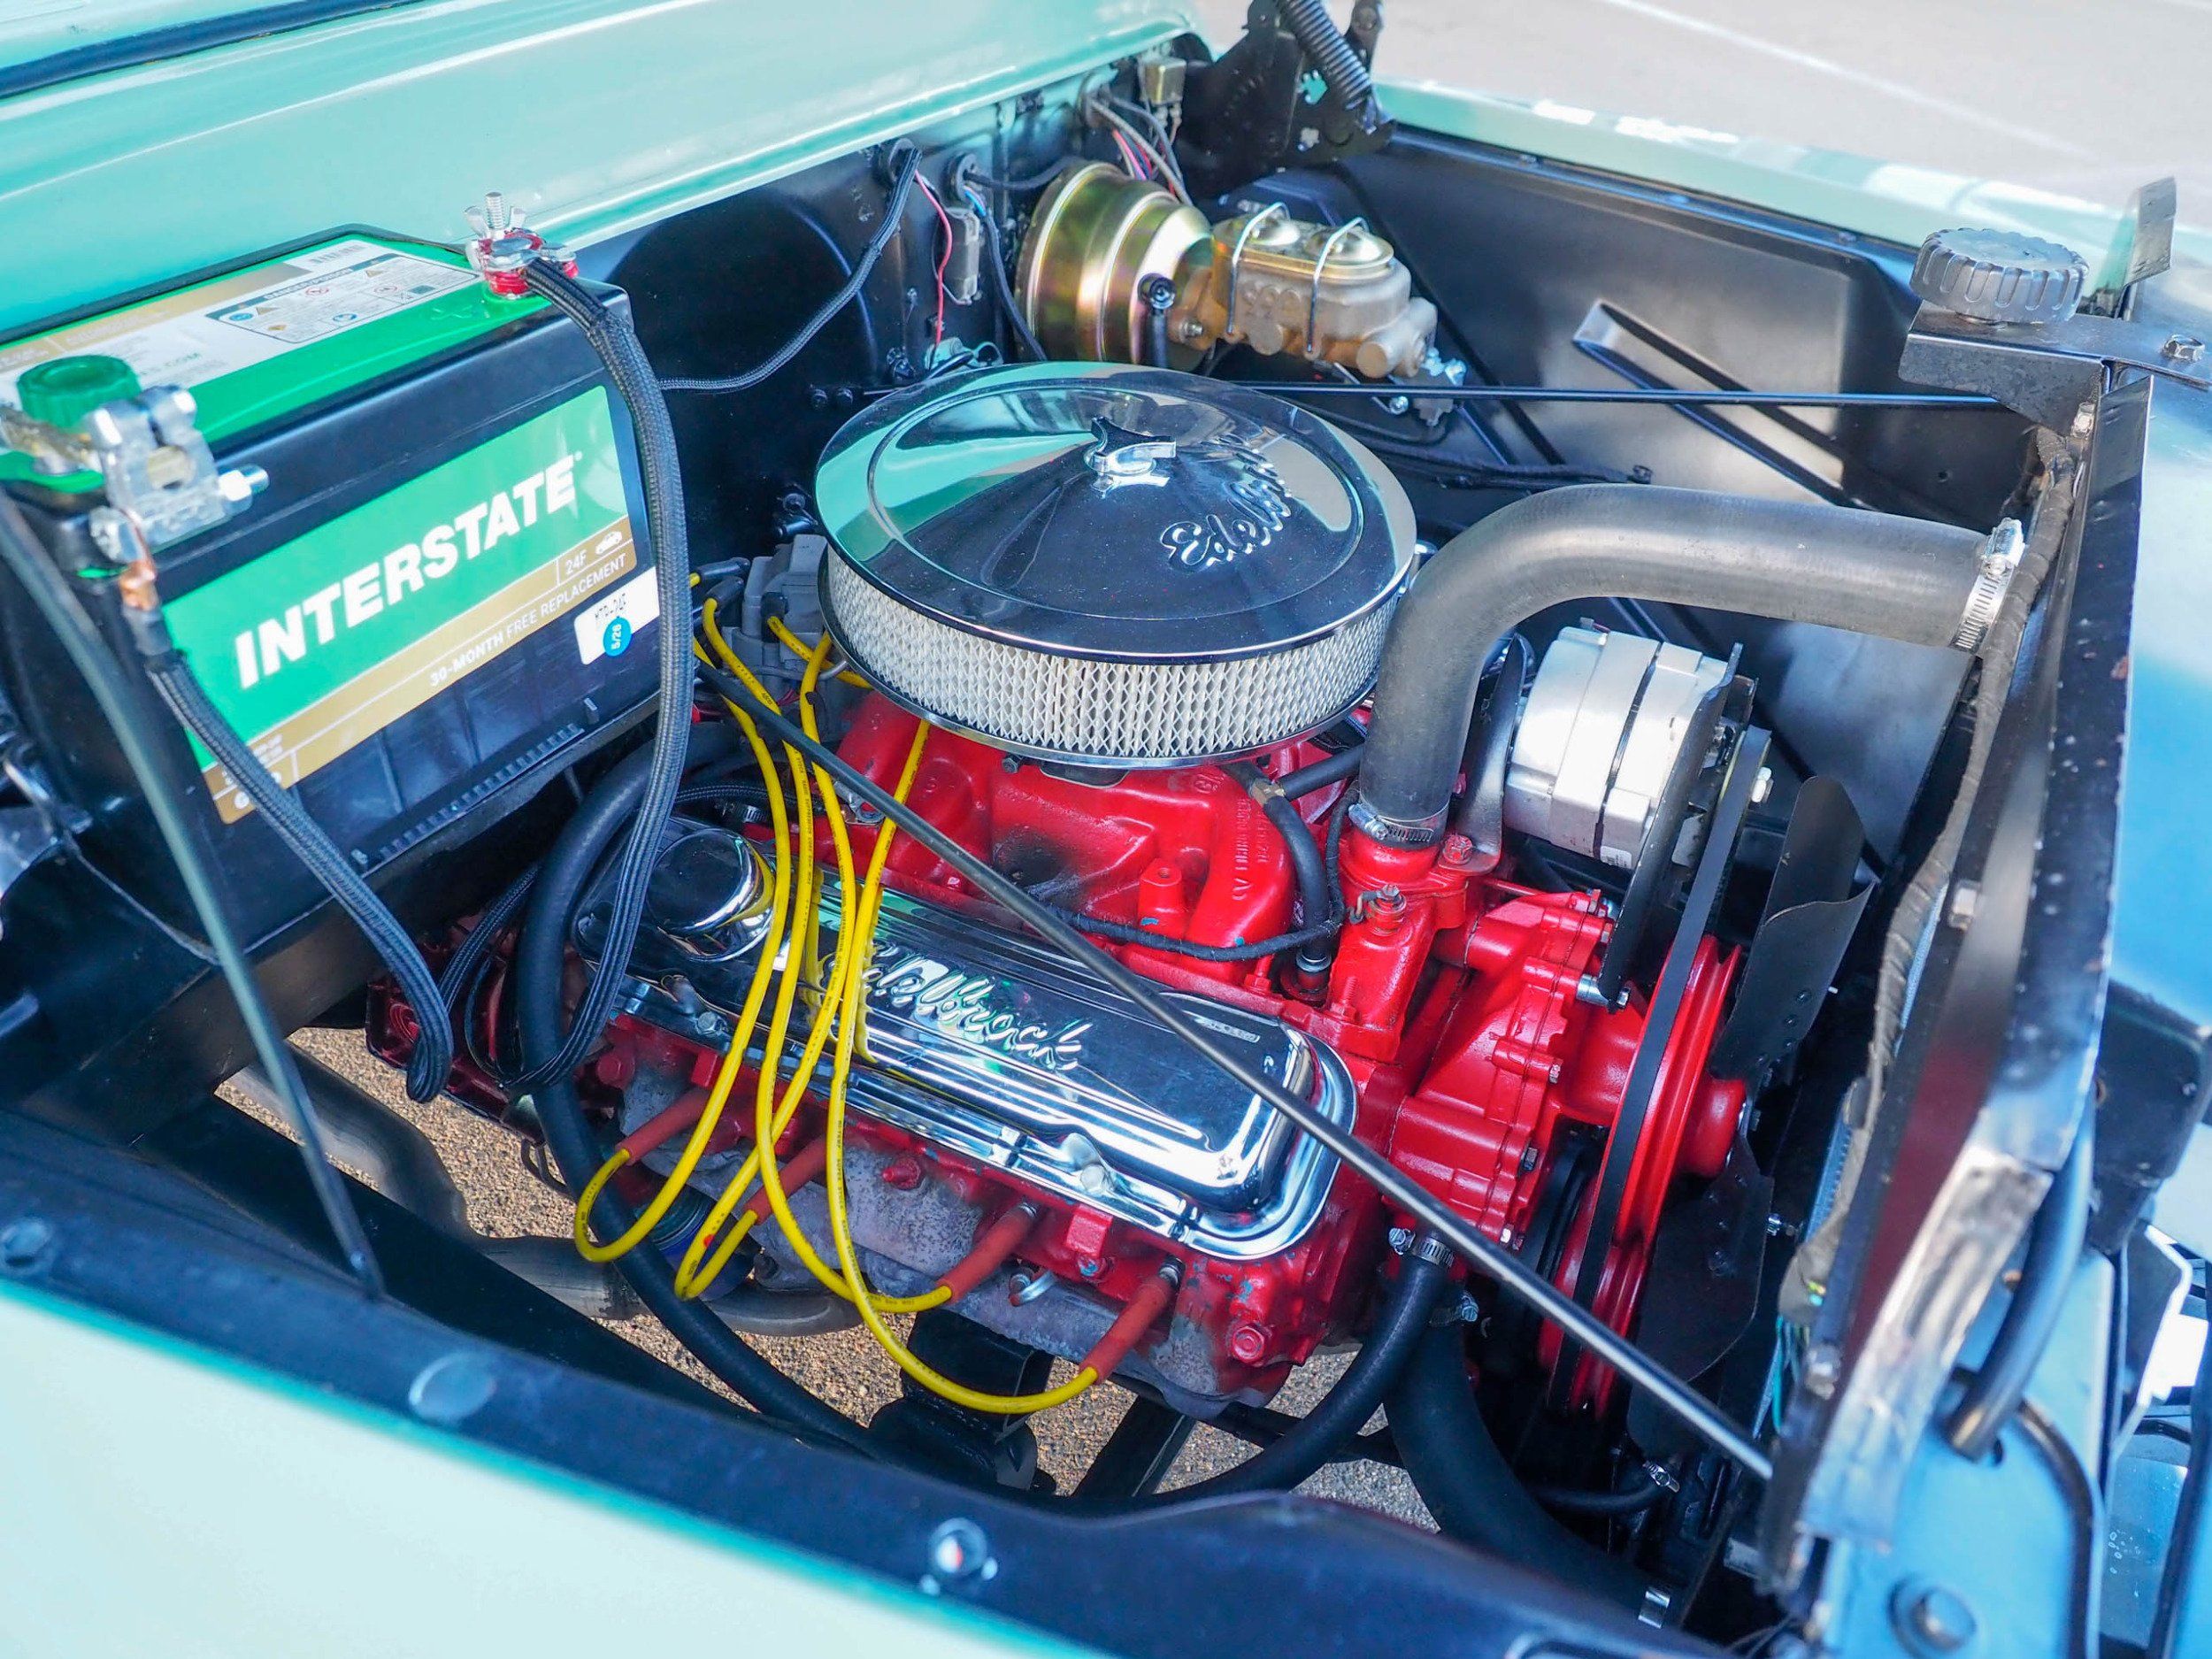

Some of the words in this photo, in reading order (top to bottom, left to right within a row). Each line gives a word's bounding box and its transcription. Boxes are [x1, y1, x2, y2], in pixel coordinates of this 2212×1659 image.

[235, 452, 576, 689] INTERSTATE
[431, 629, 504, 687] 30-MONTH
[506, 609, 538, 639] FREE
[541, 553, 626, 616] REPLACEMENT
[565, 549, 588, 576] 24F
